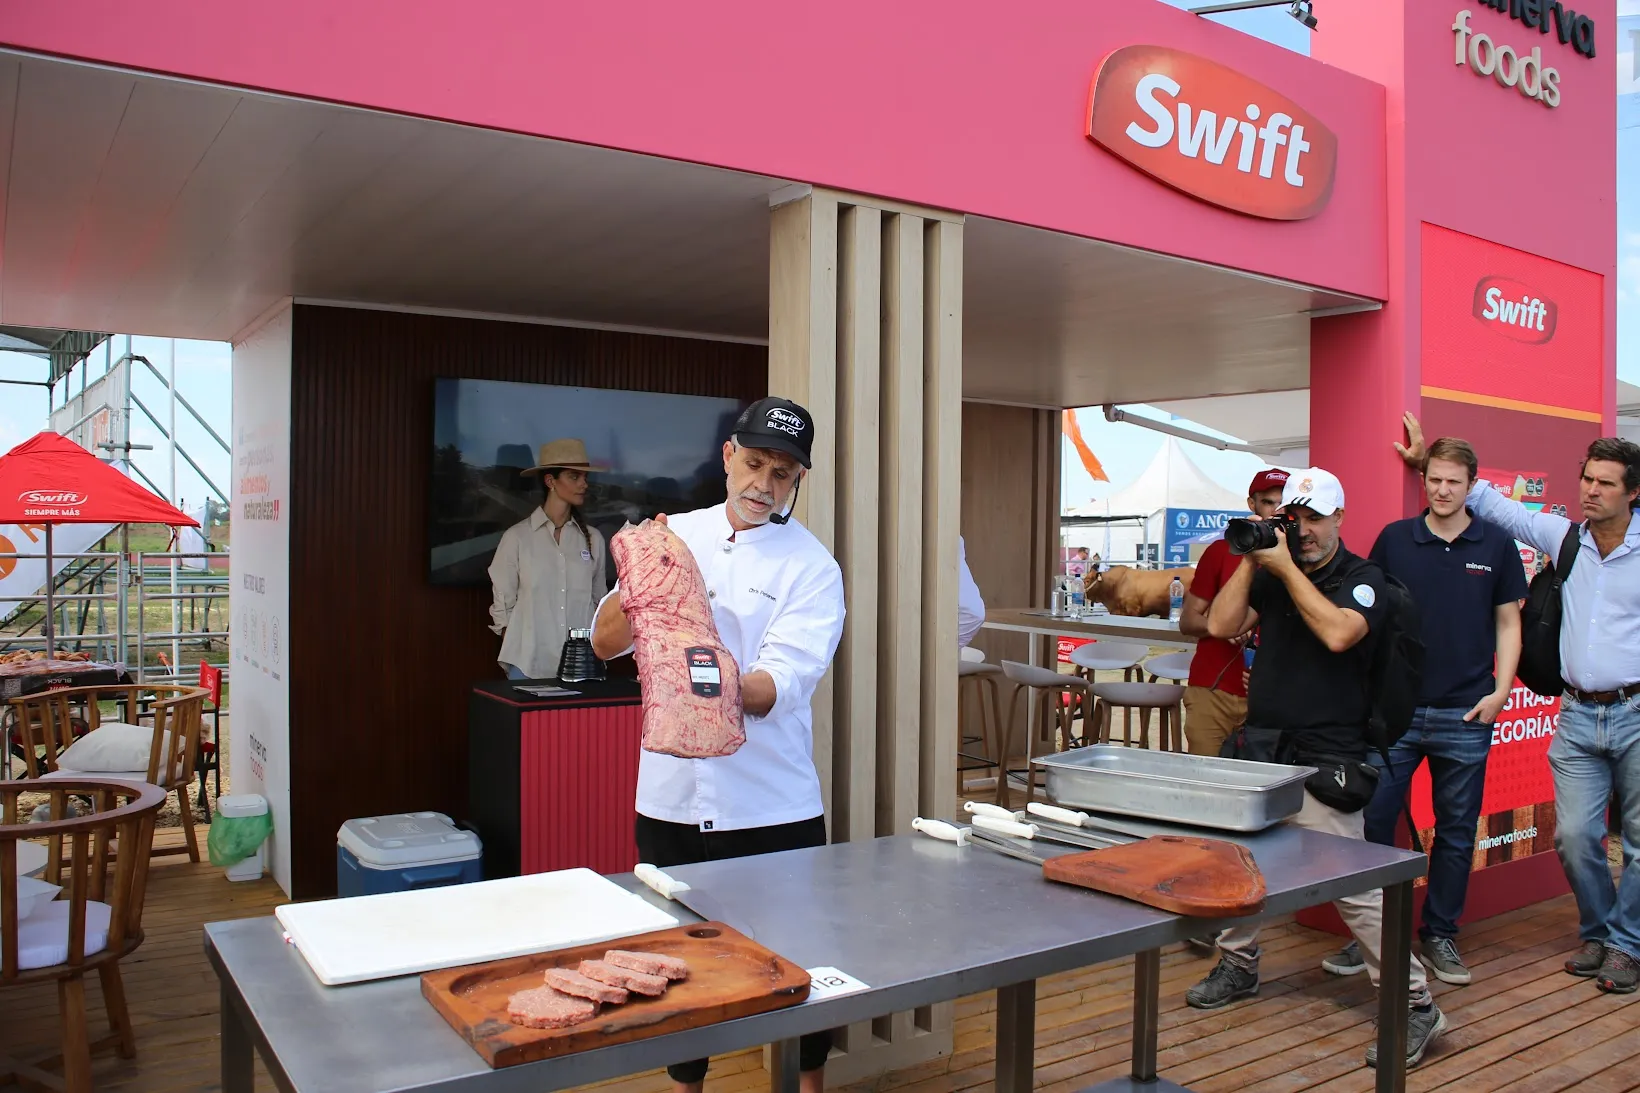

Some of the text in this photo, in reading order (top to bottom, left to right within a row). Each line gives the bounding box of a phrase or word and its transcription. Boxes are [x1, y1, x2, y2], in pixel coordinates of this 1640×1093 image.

[1477, 0, 1597, 59] erva
[1451, 9, 1561, 108] foods
[1125, 73, 1312, 188] Swift
[1481, 286, 1548, 333] Swift
[770, 410, 801, 428] Swift
[766, 421, 799, 438] BLACK
[26, 493, 79, 503] Swift
[1493, 483, 1512, 495] Swift
[24, 507, 81, 517] SIEMPRE MÁS
[1195, 512, 1248, 529] ANG
[1465, 562, 1492, 572] minerva
[1502, 686, 1555, 711] STRAS
[1490, 710, 1560, 746] EGORÍAS
